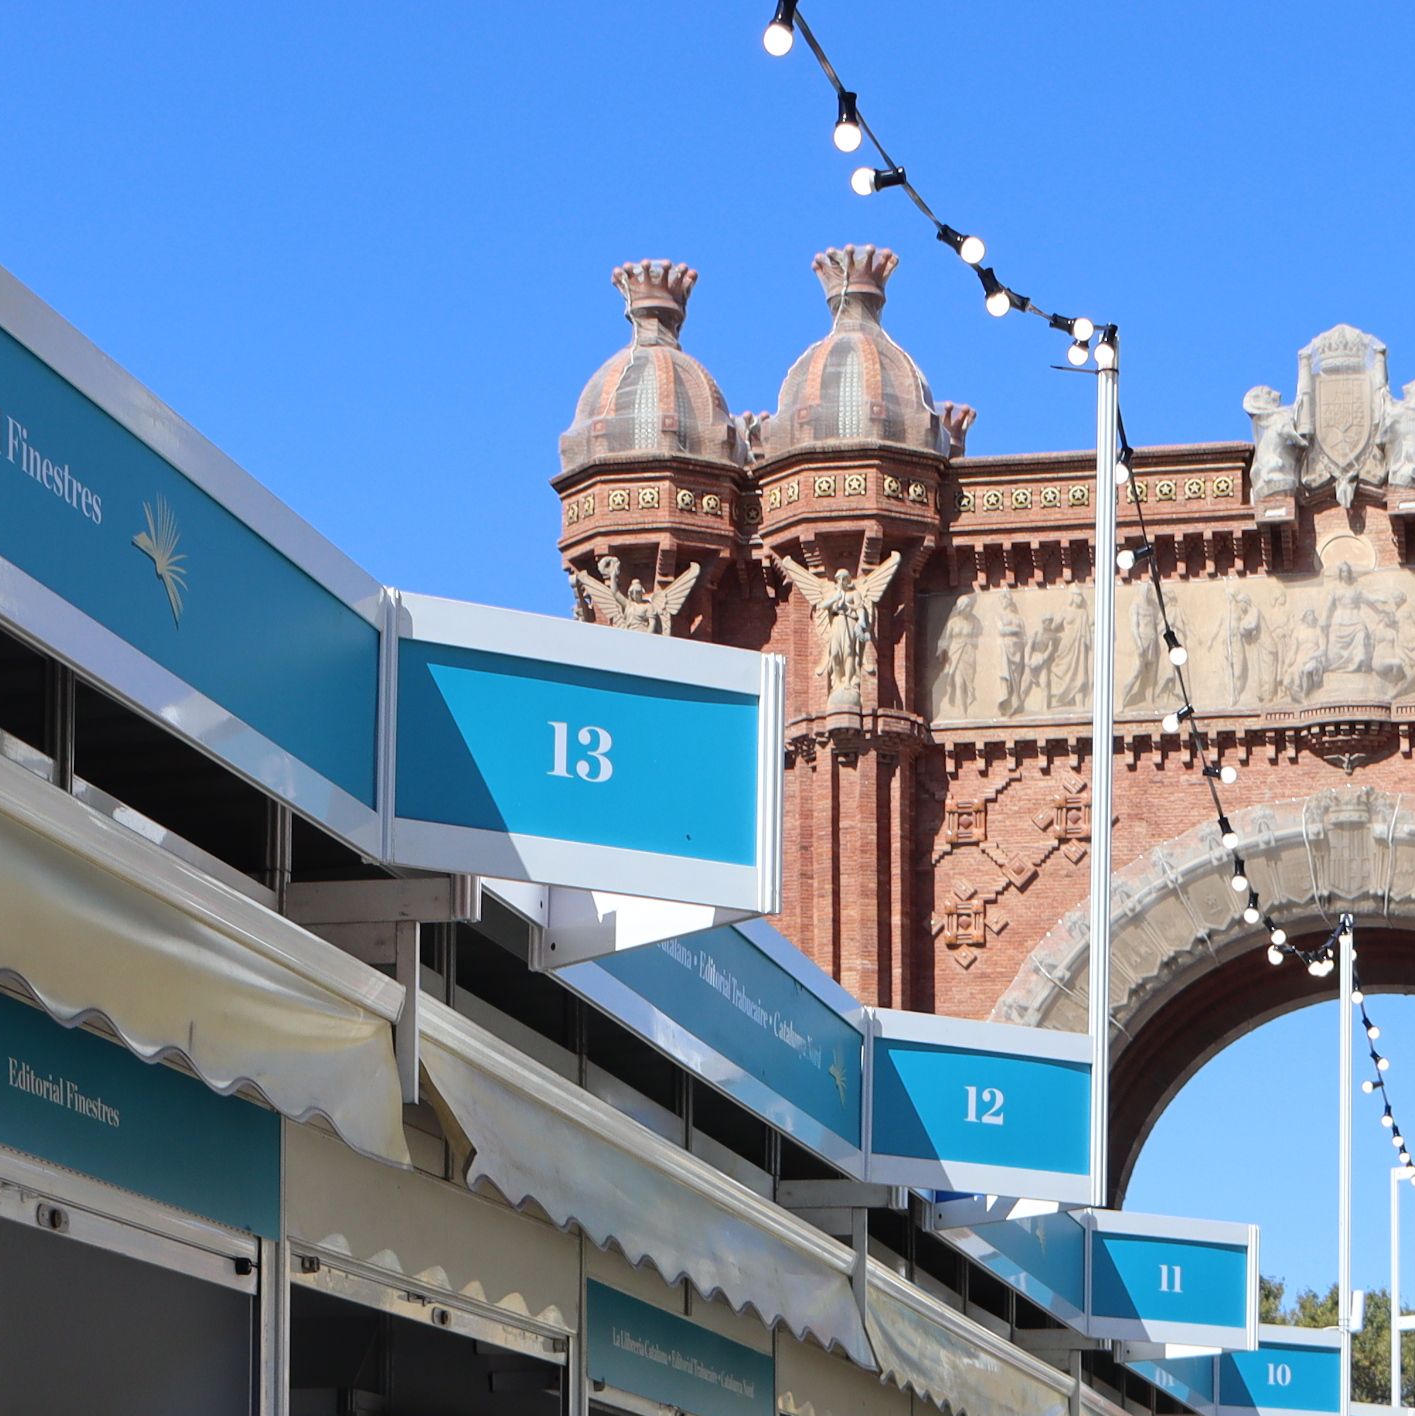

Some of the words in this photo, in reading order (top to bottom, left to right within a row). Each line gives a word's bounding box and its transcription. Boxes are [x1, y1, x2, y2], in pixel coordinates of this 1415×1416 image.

[6, 415, 103, 525] Finestres
[546, 720, 614, 785] 13
[699, 950, 731, 1001] Editorial
[731, 976, 769, 1029] Trabucaire
[7, 1055, 65, 1108] Editorial
[66, 1081, 120, 1129] Finestres
[963, 1086, 1005, 1127] 12
[1159, 1263, 1183, 1294] 11
[1267, 1361, 1291, 1387] 10
